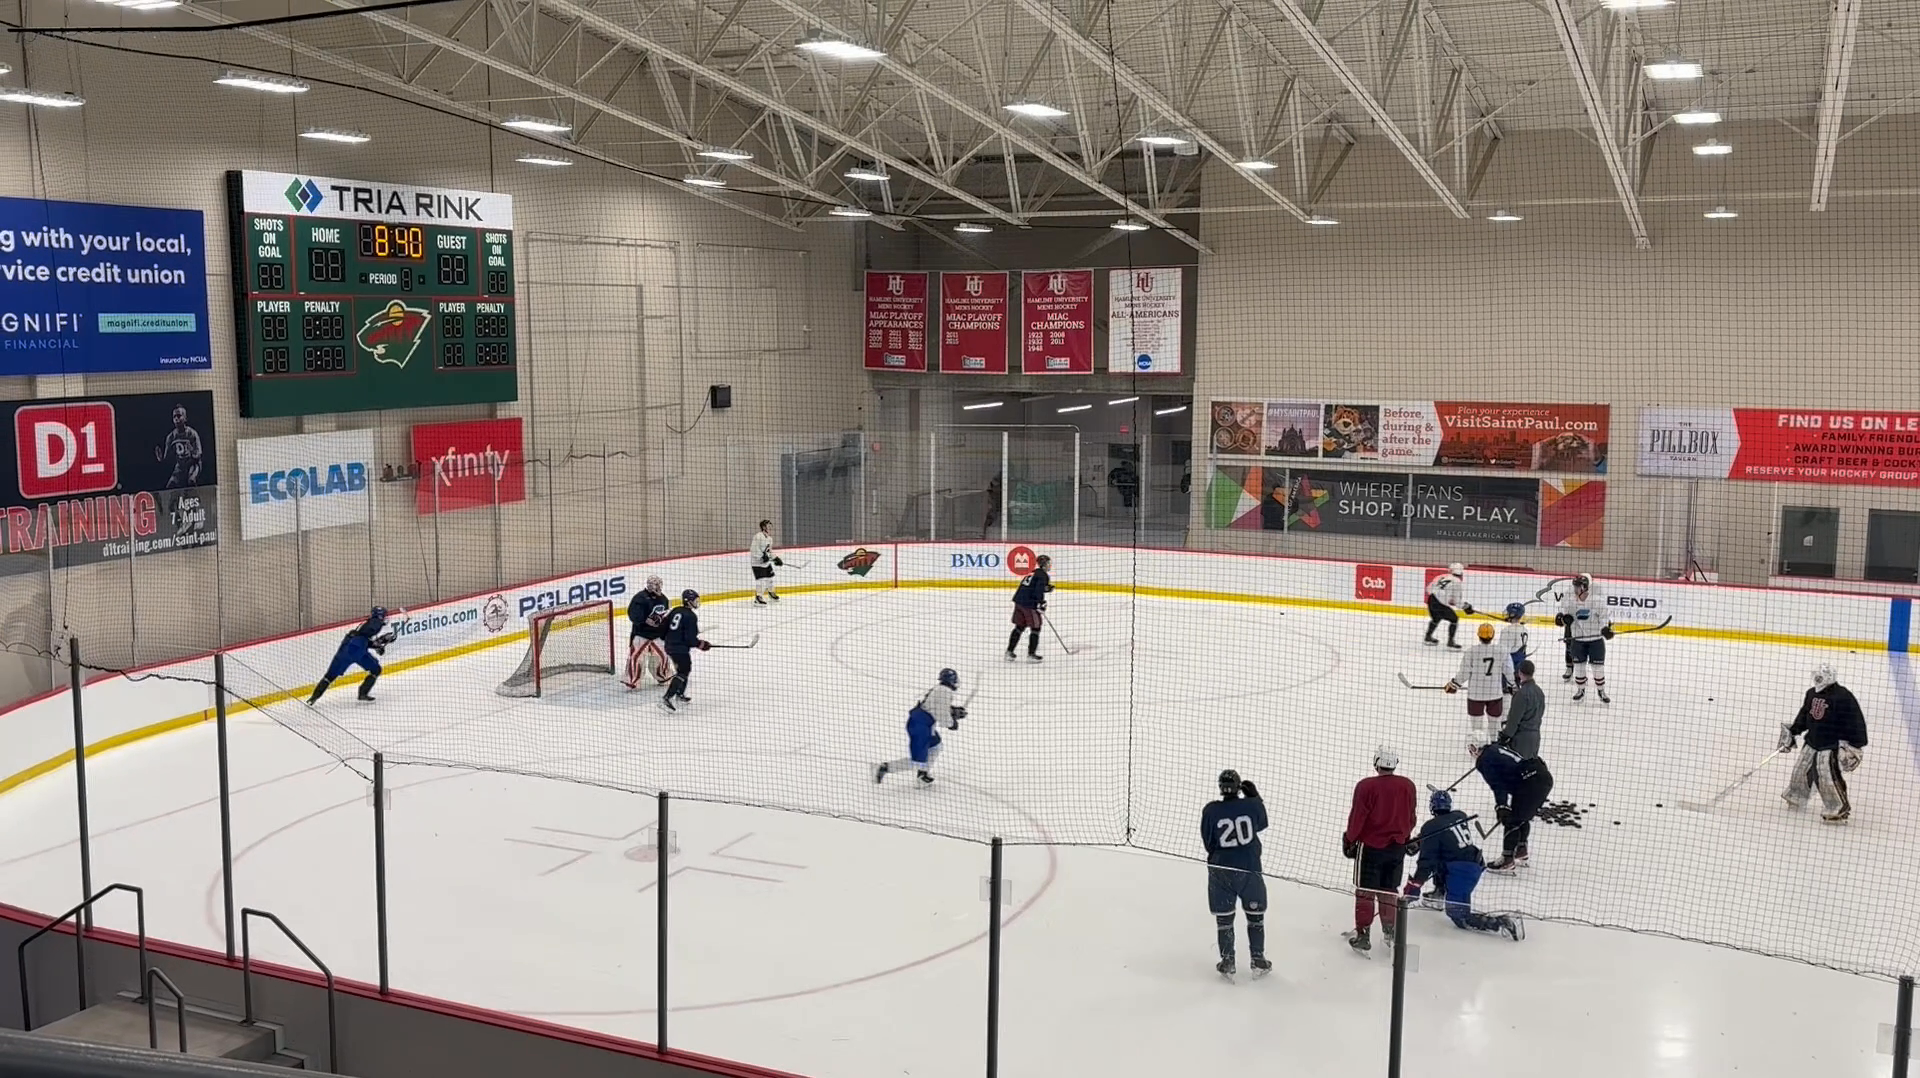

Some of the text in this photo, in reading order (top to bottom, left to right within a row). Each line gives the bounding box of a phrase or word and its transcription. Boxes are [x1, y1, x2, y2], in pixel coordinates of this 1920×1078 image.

[330, 184, 483, 221] TRIA RINK
[254, 218, 284, 232] SHOTS
[21, 226, 74, 249] with
[79, 232, 130, 255] your
[136, 232, 192, 256] local,
[263, 232, 276, 244] ON
[312, 227, 340, 244] HOME
[437, 234, 467, 250] GUEST
[485, 232, 508, 244] SHOTS
[258, 245, 282, 258] GOAL
[492, 245, 502, 255] ON
[488, 256, 506, 267] GOAL
[0, 259, 186, 285] vice credit union
[369, 273, 397, 285] PERIOD
[257, 301, 341, 313] PLAYER PENALTY
[439, 302, 505, 313] PLAYER PENALTY
[870, 311, 923, 321] MIAC PLAYOFF
[946, 313, 1003, 322] MIAC PLAYOFF
[1047, 312, 1069, 321] MIAC
[1111, 310, 1180, 319] ALL-AMERICANS
[1, 312, 189, 333] GNIFI magnifi.creditunion
[869, 320, 924, 329] APPEARANCES
[948, 321, 1000, 330] CHAMPIONS
[1031, 321, 1085, 330] CHAMPIONS
[4, 339, 79, 350] FINANCIAL
[182, 356, 190, 365] by
[1383, 407, 1425, 420] Before,
[1457, 406, 1551, 417] Plan your experience
[1382, 421, 1434, 434] during &
[1444, 415, 1599, 431] VisitSaintPaul.com
[1777, 414, 1919, 431] FIND US ON LE
[1382, 434, 1431, 446] after the
[1649, 429, 1719, 454] PILLBOX
[1821, 432, 1865, 442] FAMILY
[34, 421, 105, 479] D1
[1793, 443, 1836, 453] AWARD
[1839, 445, 1894, 455] WINNING
[431, 444, 510, 487] xfinity
[1794, 456, 1833, 465] CRAFT
[1837, 457, 1868, 466] BEER
[1872, 458, 1880, 467] &
[1745, 465, 1918, 480] RESERVE YOUR HOCKEY GROUP
[250, 461, 367, 505] ECOLAB
[1340, 481, 1463, 501] WHERE FANS
[178, 496, 199, 510] Ages
[1339, 499, 1519, 523] SHOP. DINE. PLAY.
[1437, 530, 1520, 540] MALLOFAMERICA.COM
[102, 528, 217, 557] d1traiing.com/saint-paul
[951, 553, 1000, 568] BMO
[1362, 576, 1386, 589] Cub
[519, 576, 626, 618] POLARIS
[1607, 596, 1657, 609] BEND
[669, 613, 682, 630] 9
[1483, 656, 1495, 677] 7
[1217, 815, 1254, 848] 20
